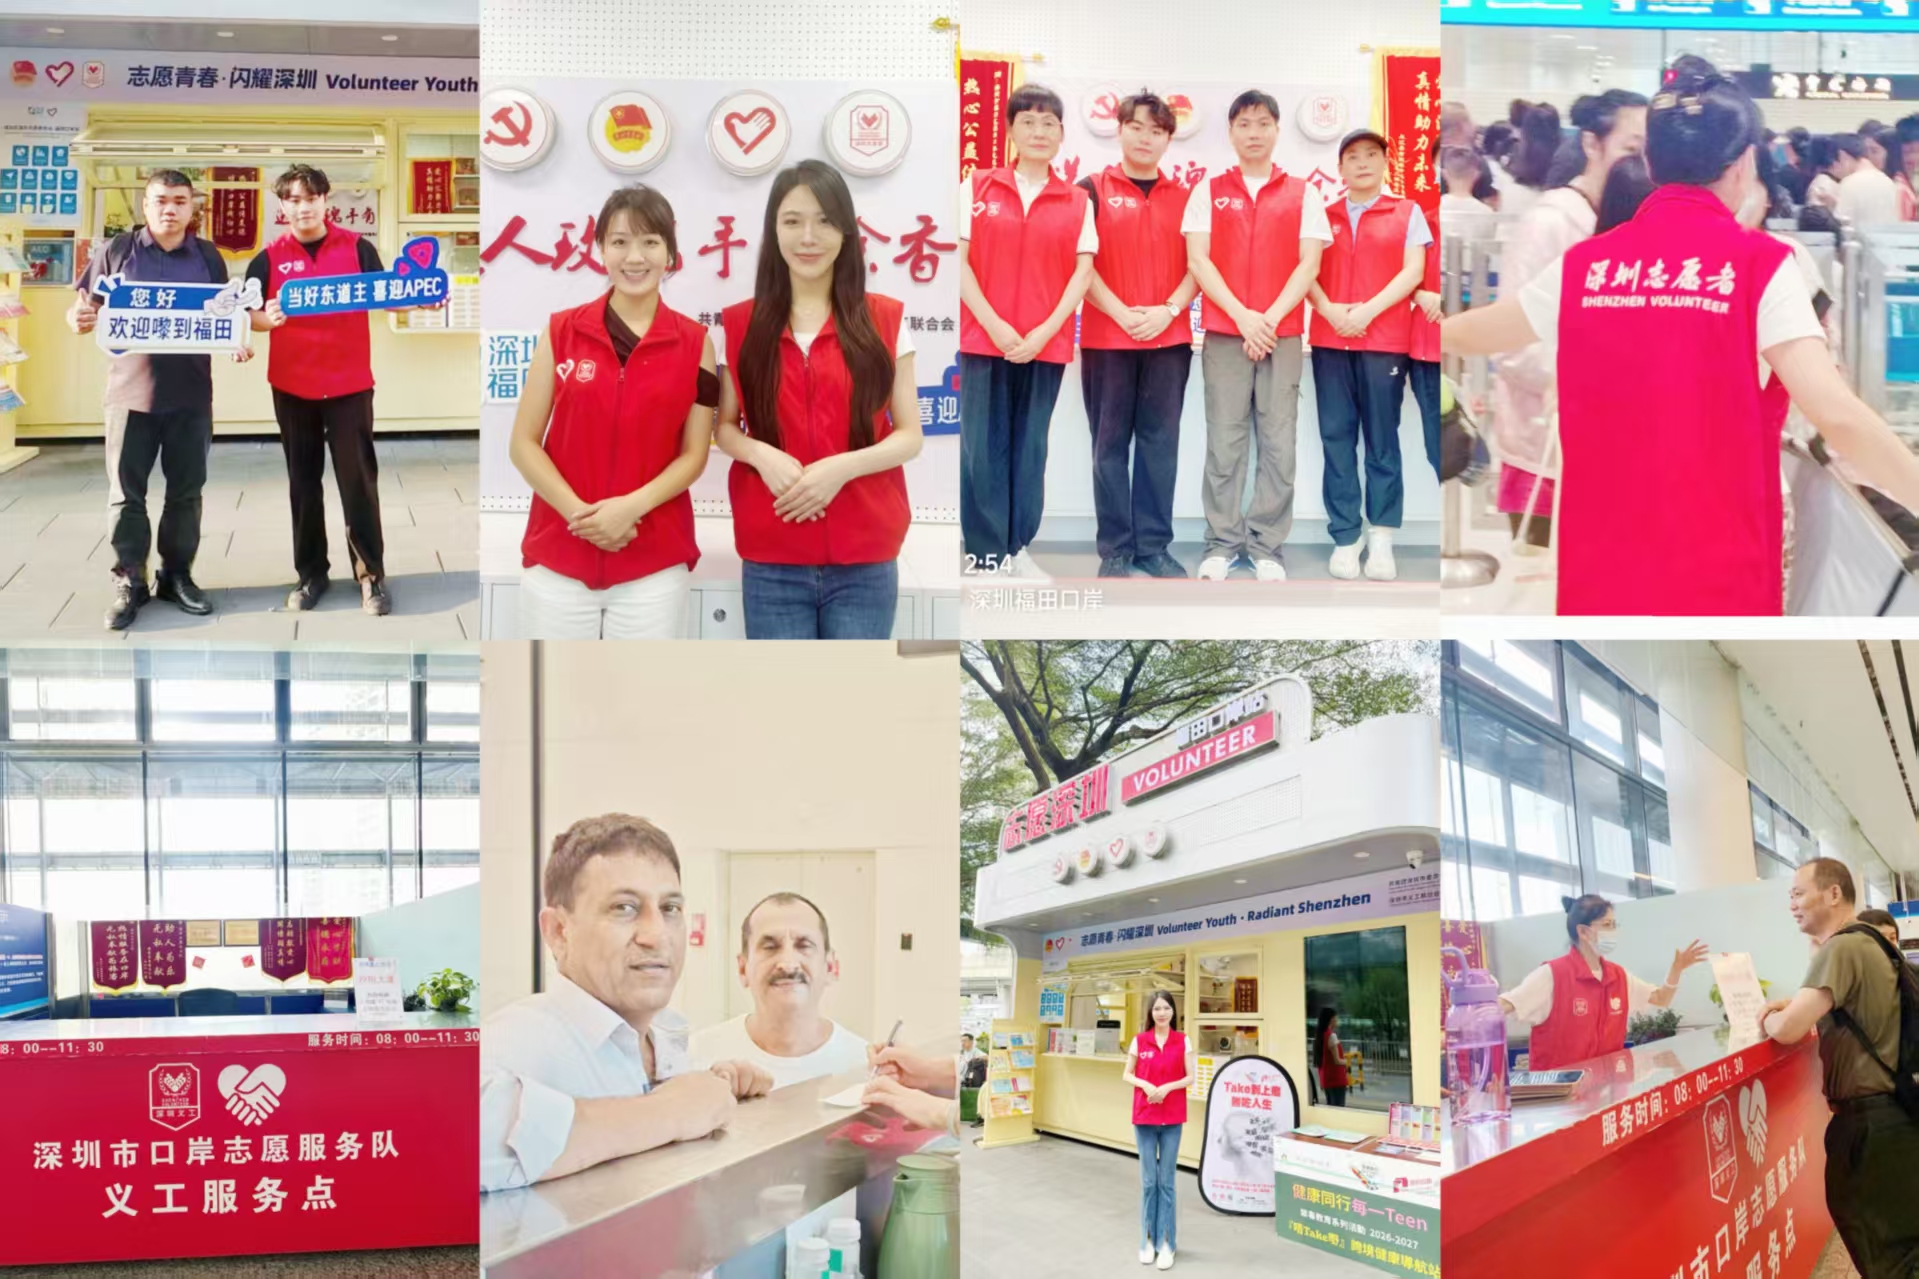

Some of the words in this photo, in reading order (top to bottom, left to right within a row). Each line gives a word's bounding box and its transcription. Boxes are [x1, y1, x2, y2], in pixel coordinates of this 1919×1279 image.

[326, 74, 419, 92] Volunteer
[425, 77, 479, 93] Youth
[129, 287, 177, 309] 您好
[288, 281, 368, 309] 当好东道主
[373, 276, 442, 301] 喜迎APEC
[1581, 295, 1646, 308] SHENZHEN
[1650, 295, 1730, 314] VOLUNTEER
[1133, 725, 1257, 793] VOLUNTEER
[1157, 921, 1204, 936] Volunteer
[1205, 913, 1237, 928] Youth
[1247, 904, 1295, 922] Radiant
[1298, 893, 1371, 914] Shenzhen
[33, 1130, 399, 1170] 深圳市口岸志愿服务队
[102, 1175, 337, 1218] 义工服务点
[1370, 1228, 1419, 1249] 2026-2027
